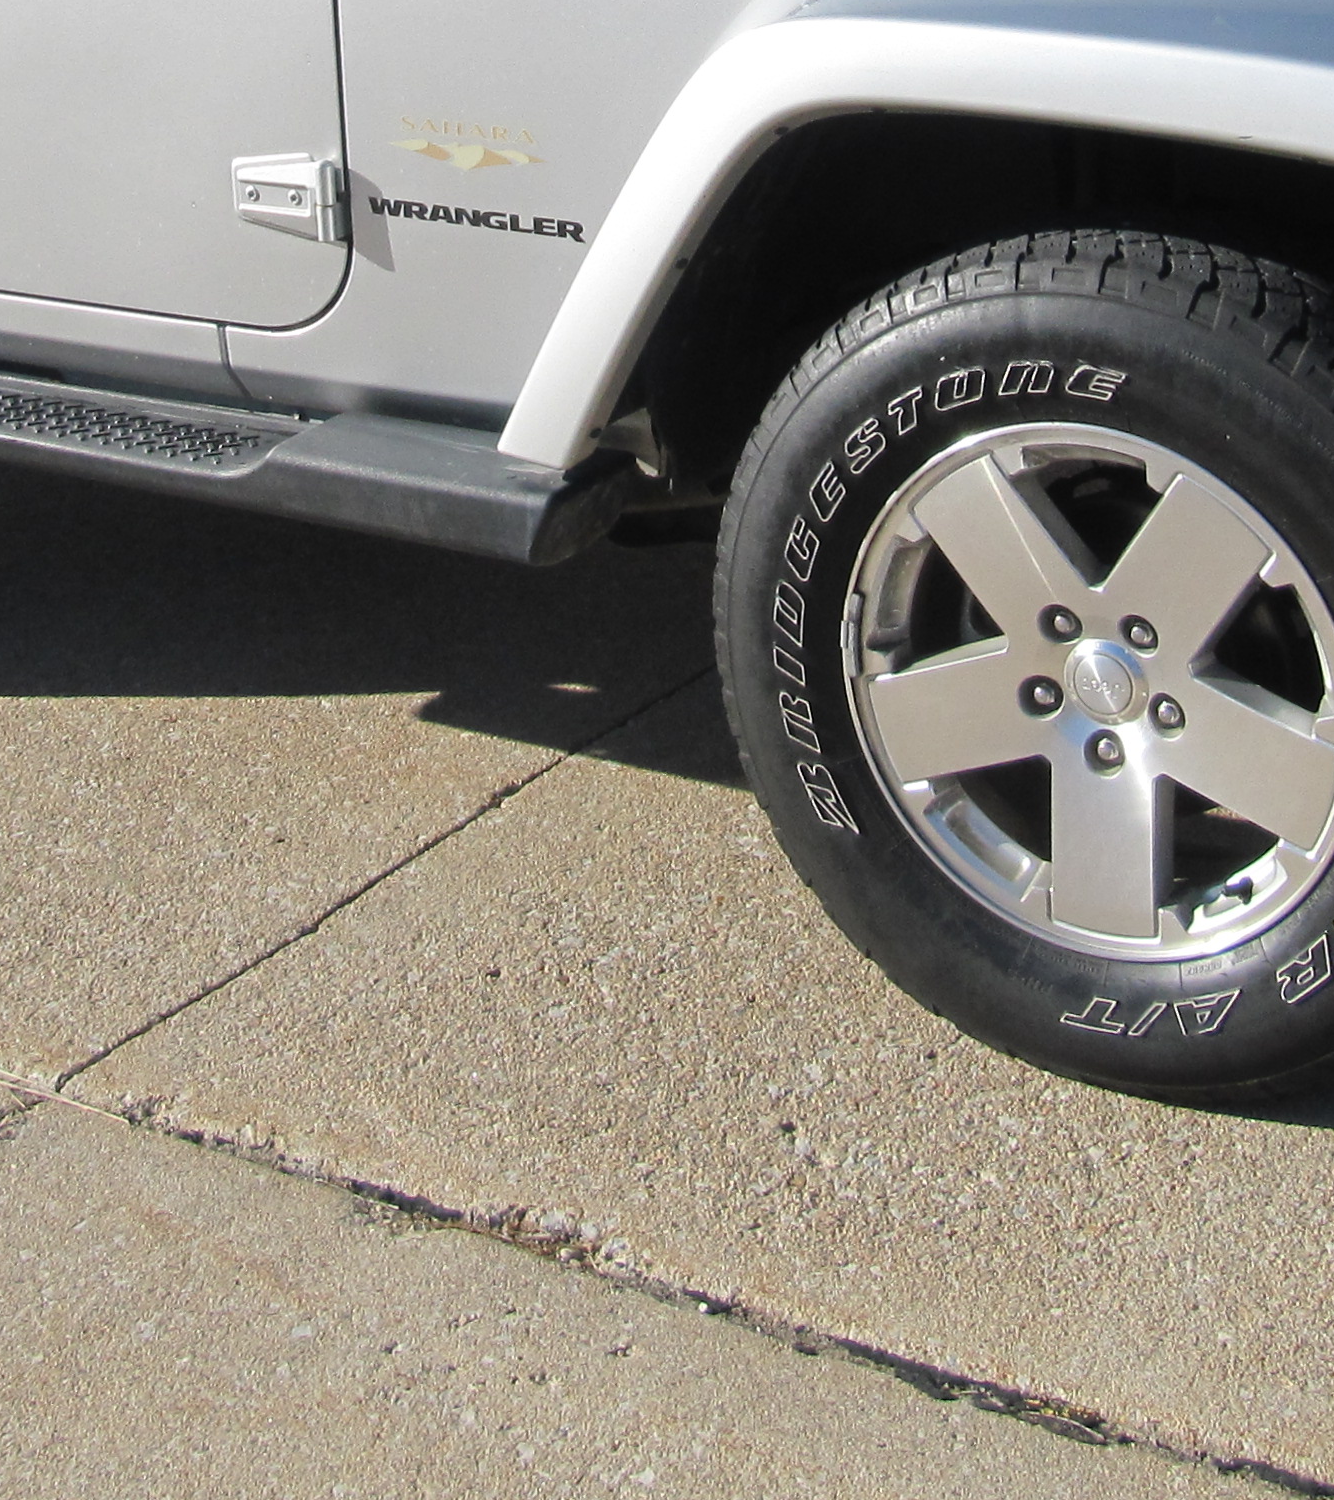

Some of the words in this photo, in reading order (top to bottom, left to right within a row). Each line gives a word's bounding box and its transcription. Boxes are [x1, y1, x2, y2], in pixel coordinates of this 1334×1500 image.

[401, 115, 536, 145] SAHARA
[368, 196, 587, 244] WRANGLER
[772, 359, 1127, 836] BRIDGESTONE
[1059, 988, 1243, 1037] A/T
